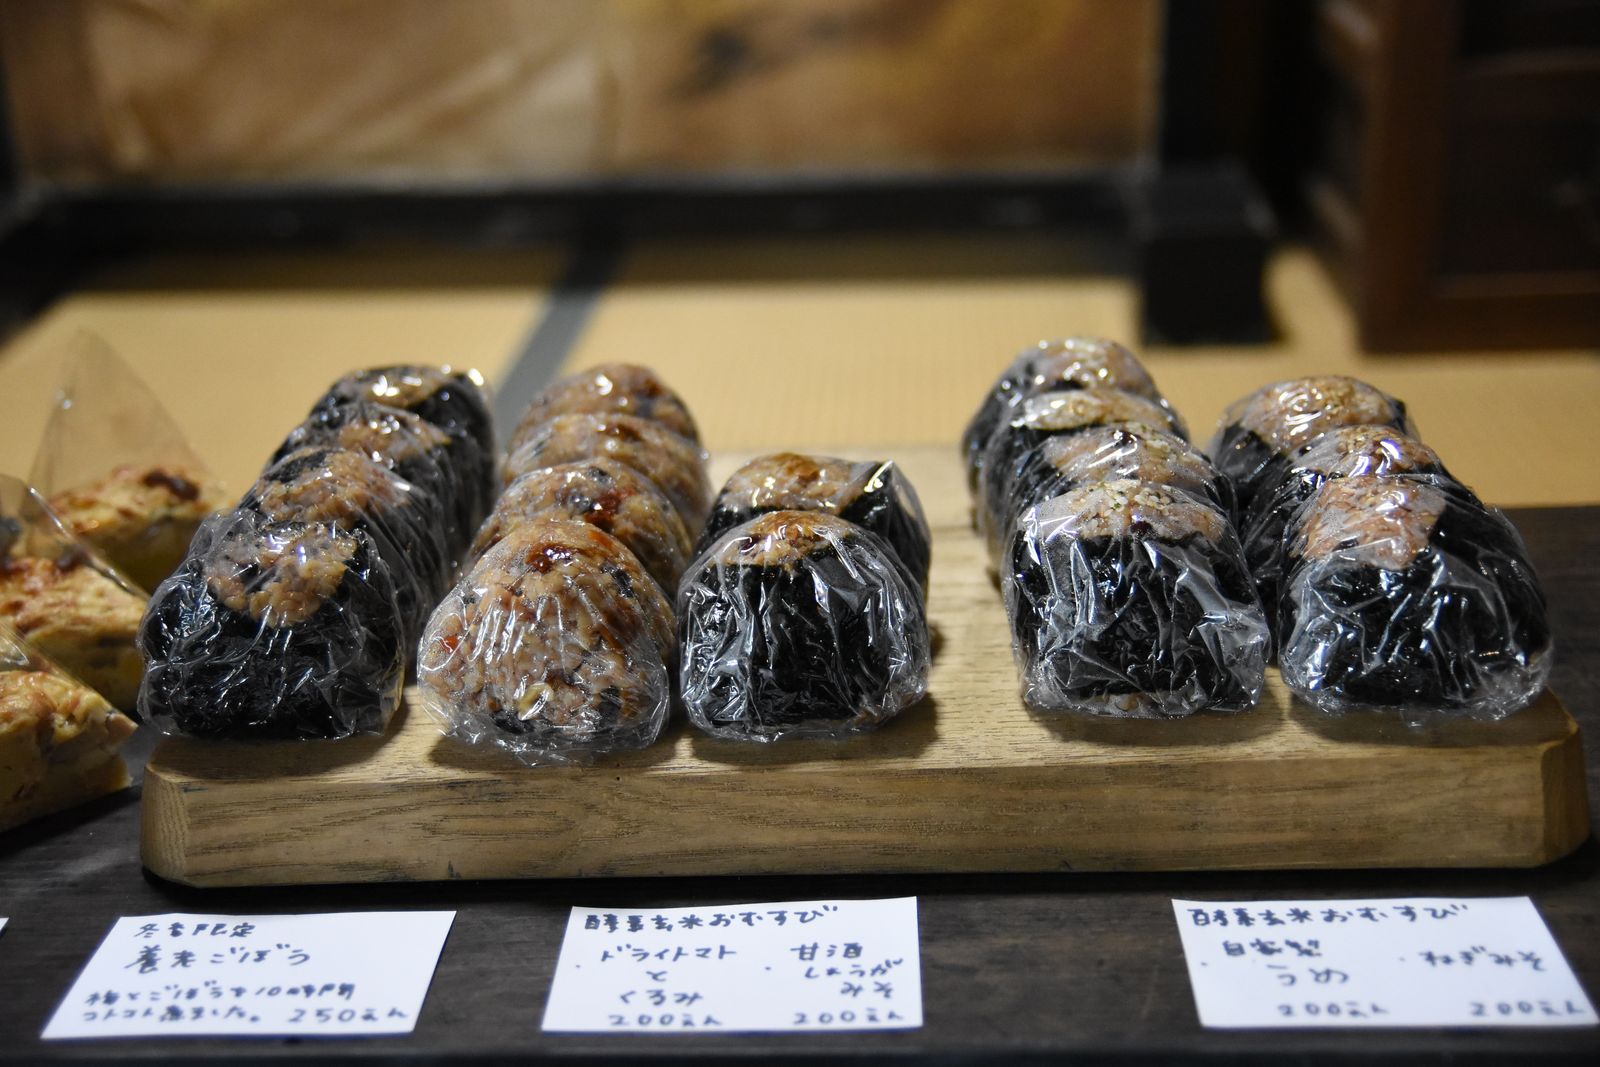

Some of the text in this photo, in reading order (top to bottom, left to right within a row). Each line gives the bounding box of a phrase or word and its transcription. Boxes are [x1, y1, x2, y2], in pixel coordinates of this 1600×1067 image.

[1187, 905, 1468, 926] 酵素玄米おむすび
[601, 944, 736, 962] ドライトマト
[790, 942, 863, 960] 甘酒
[1419, 946, 1545, 972] ねぎみそ
[646, 971, 667, 982] と
[804, 958, 903, 979] しょうが
[1267, 964, 1349, 986] うめ
[840, 981, 893, 999] みそ
